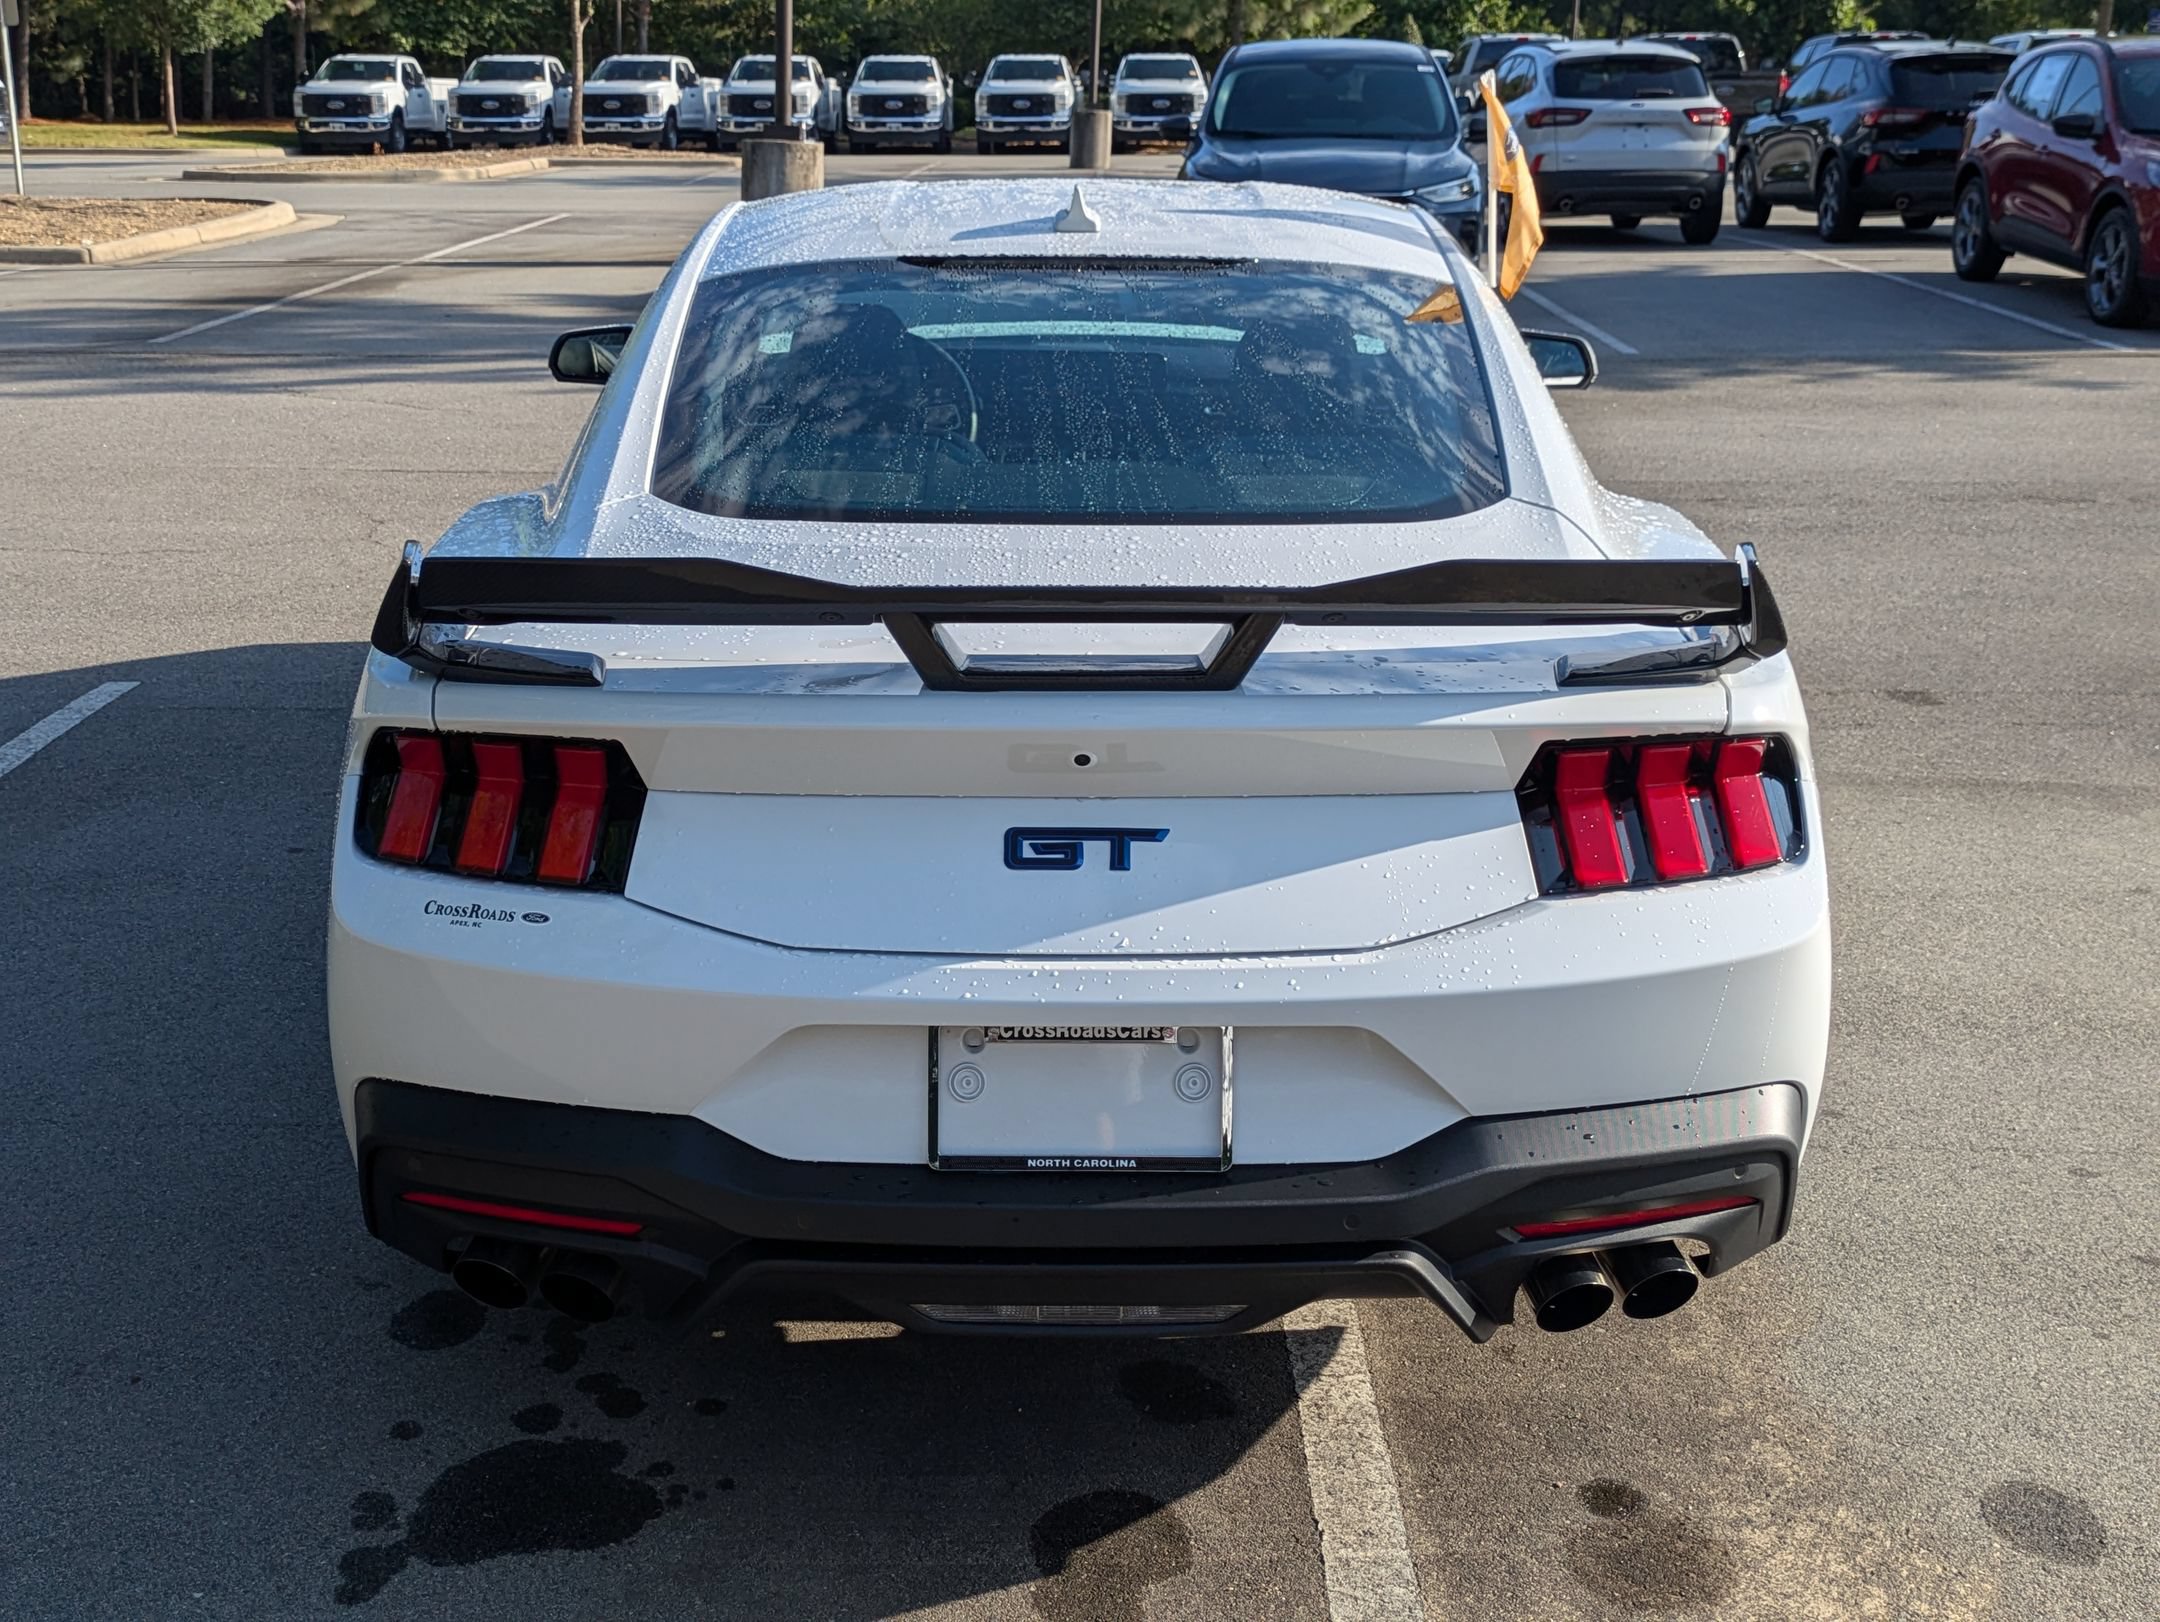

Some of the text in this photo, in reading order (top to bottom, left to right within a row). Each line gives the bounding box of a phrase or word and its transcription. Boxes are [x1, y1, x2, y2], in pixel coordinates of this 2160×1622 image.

[1004, 827, 1170, 871] GT
[1027, 1159, 1137, 1167] NORTH CAROLINA
